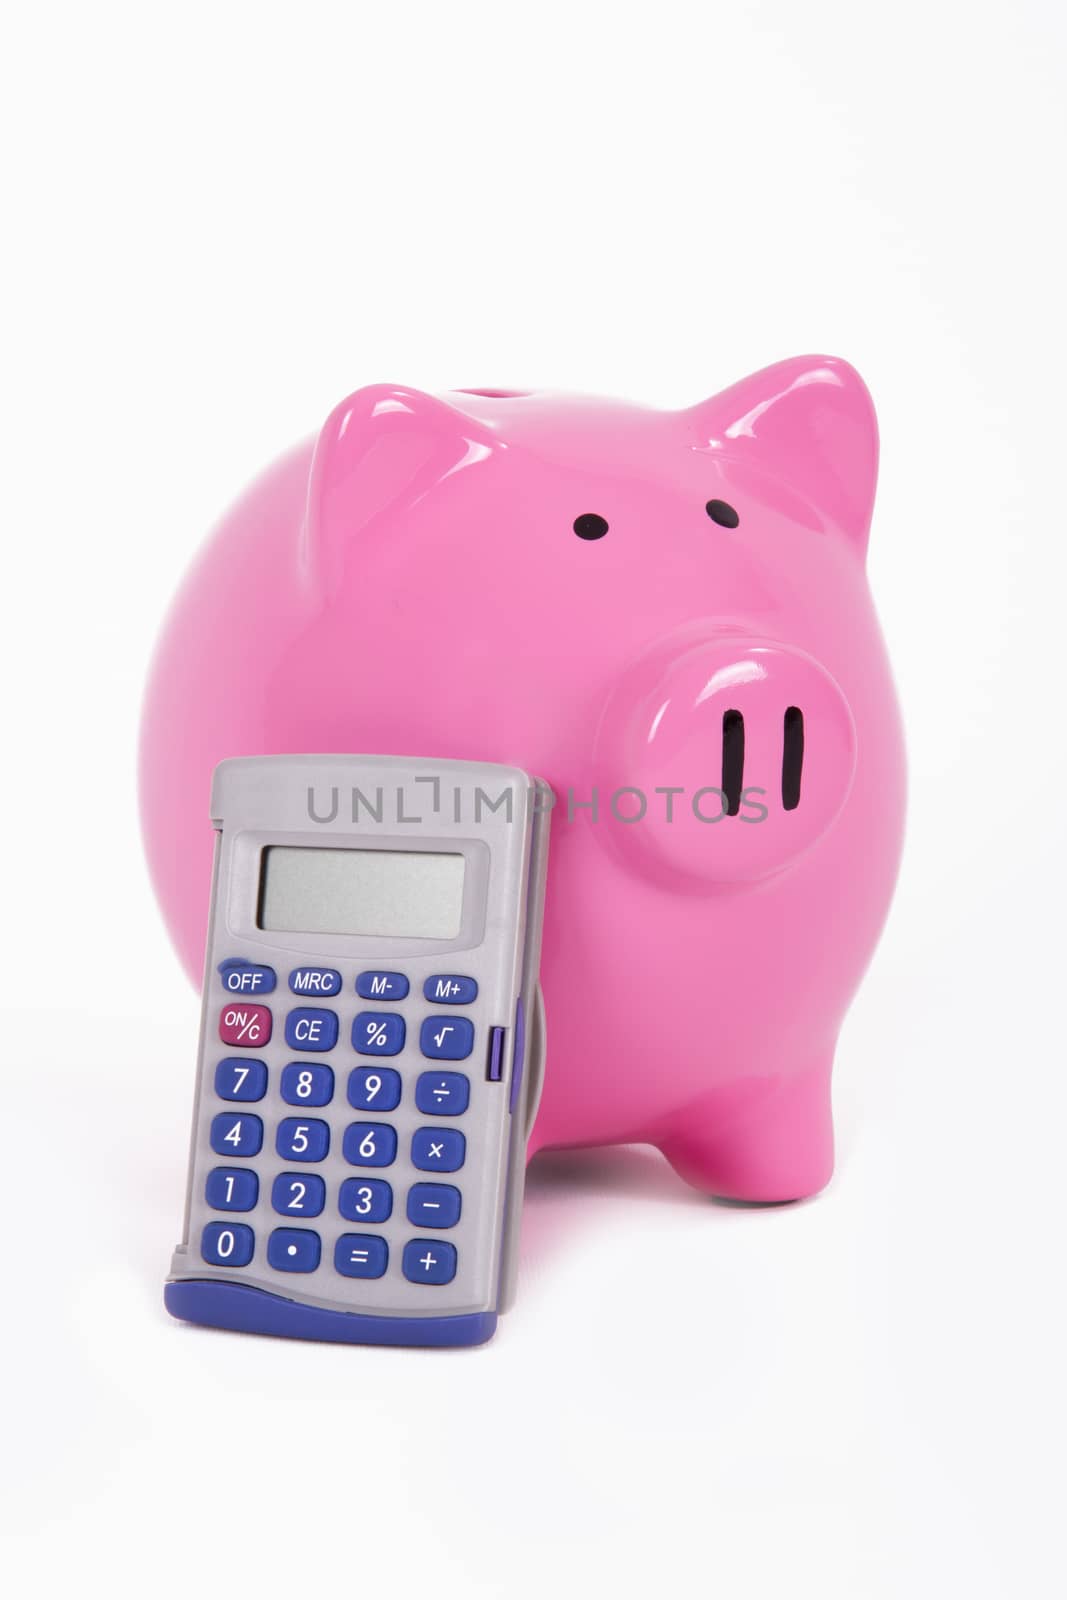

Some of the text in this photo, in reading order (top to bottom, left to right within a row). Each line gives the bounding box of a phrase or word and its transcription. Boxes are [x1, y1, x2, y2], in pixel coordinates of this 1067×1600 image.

[228, 971, 460, 997] OFF MRC M- M+
[295, 1019, 322, 1041] CE
[367, 1022, 386, 1046] %
[233, 1068, 249, 1093] 7
[296, 1072, 312, 1097] 8
[366, 1075, 381, 1102] 9
[224, 1121, 241, 1146] 4
[292, 1127, 308, 1152] 5
[360, 1131, 375, 1157] 6
[226, 1177, 234, 1202] 1
[288, 1183, 305, 1208] 2
[356, 1187, 372, 1214] 3
[218, 1231, 234, 1257] 0
[351, 1251, 368, 1262] =
[420, 1252, 436, 1270] +
